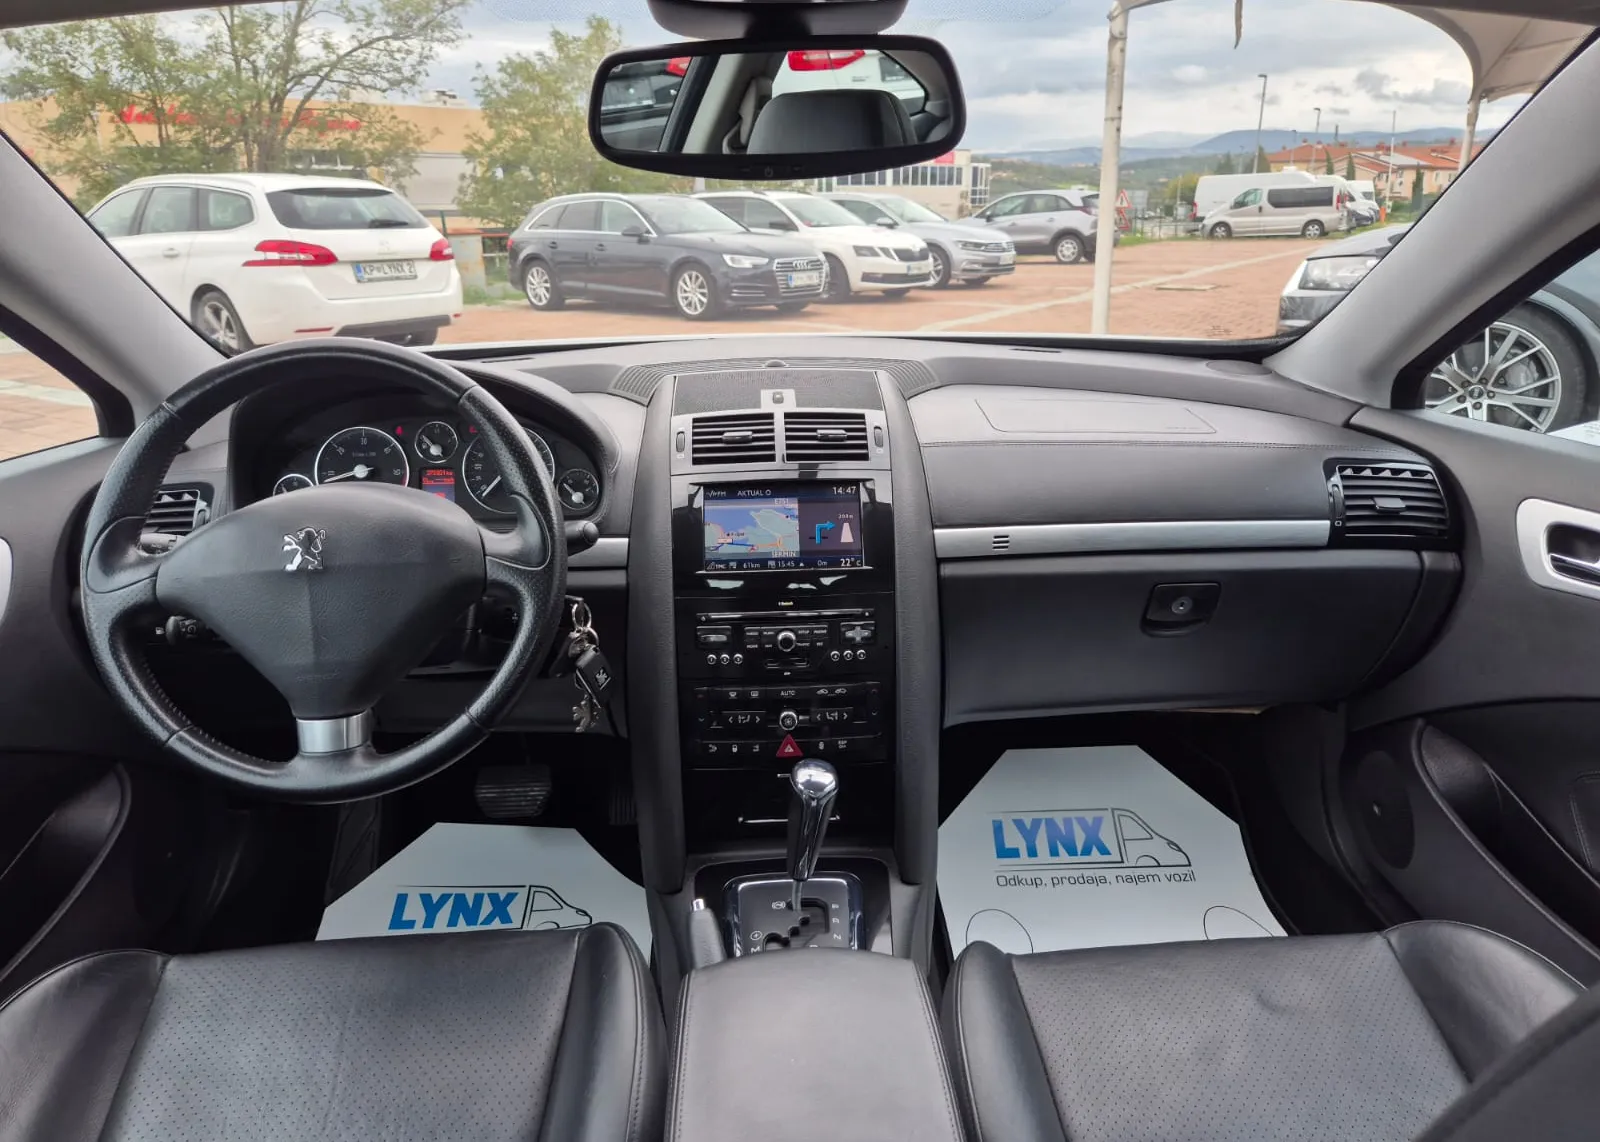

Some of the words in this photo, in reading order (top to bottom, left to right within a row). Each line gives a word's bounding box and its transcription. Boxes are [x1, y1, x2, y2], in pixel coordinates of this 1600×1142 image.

[383, 262, 406, 275] LYNX
[737, 489, 764, 497] AKTUAL
[832, 486, 857, 495] 14:47
[771, 550, 796, 558] SERMIN
[991, 816, 1112, 859] LYNX
[996, 874, 1048, 889] Odkup,
[1051, 872, 1112, 888] prodaja,
[1115, 872, 1161, 887] najem
[1165, 869, 1197, 883] vozil
[388, 892, 519, 930] LYNX
